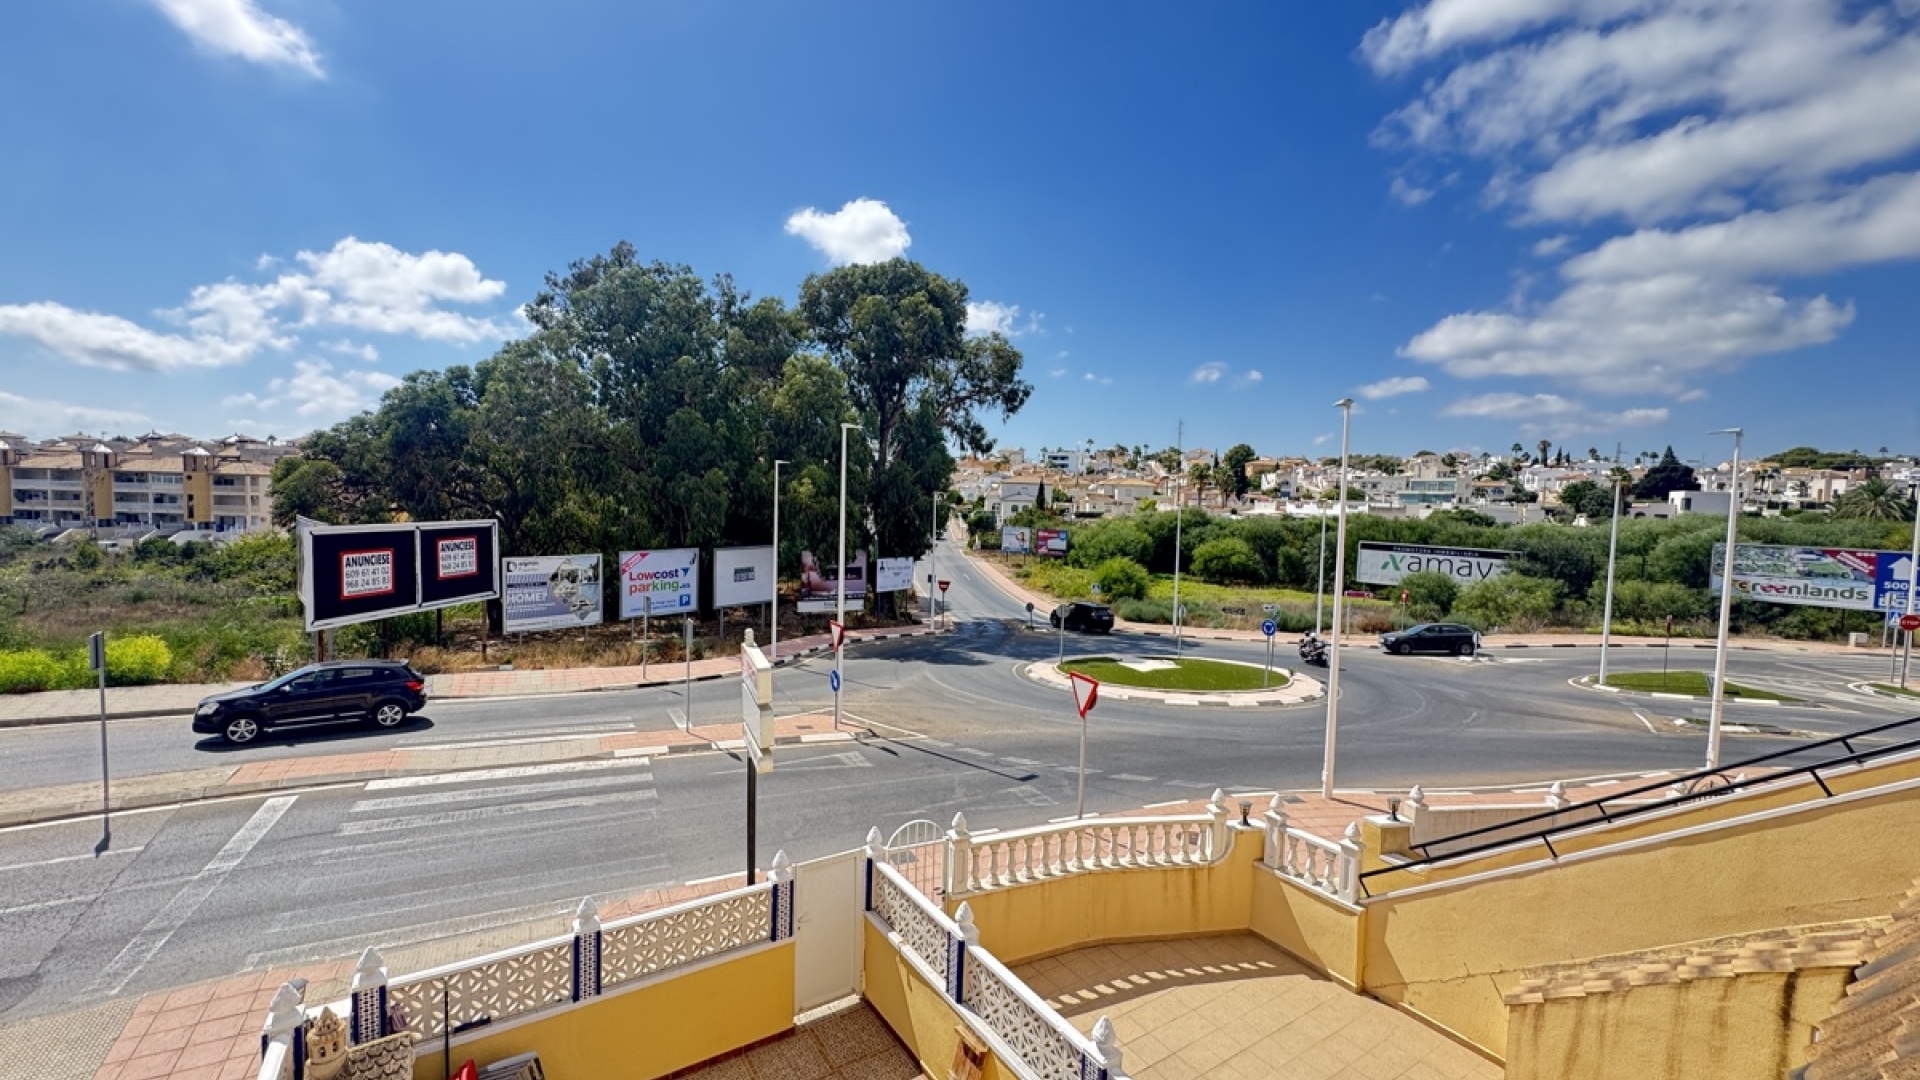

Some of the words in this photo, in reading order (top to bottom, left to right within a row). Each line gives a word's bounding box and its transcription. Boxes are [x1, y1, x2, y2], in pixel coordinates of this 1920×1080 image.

[346, 553, 390, 568] ANUNCIESE
[346, 569, 360, 579] 609
[362, 568, 370, 577] 61
[371, 567, 380, 576] 41
[629, 568, 679, 581] Lowcost
[346, 579, 360, 589] 968
[362, 578, 370, 588] 24
